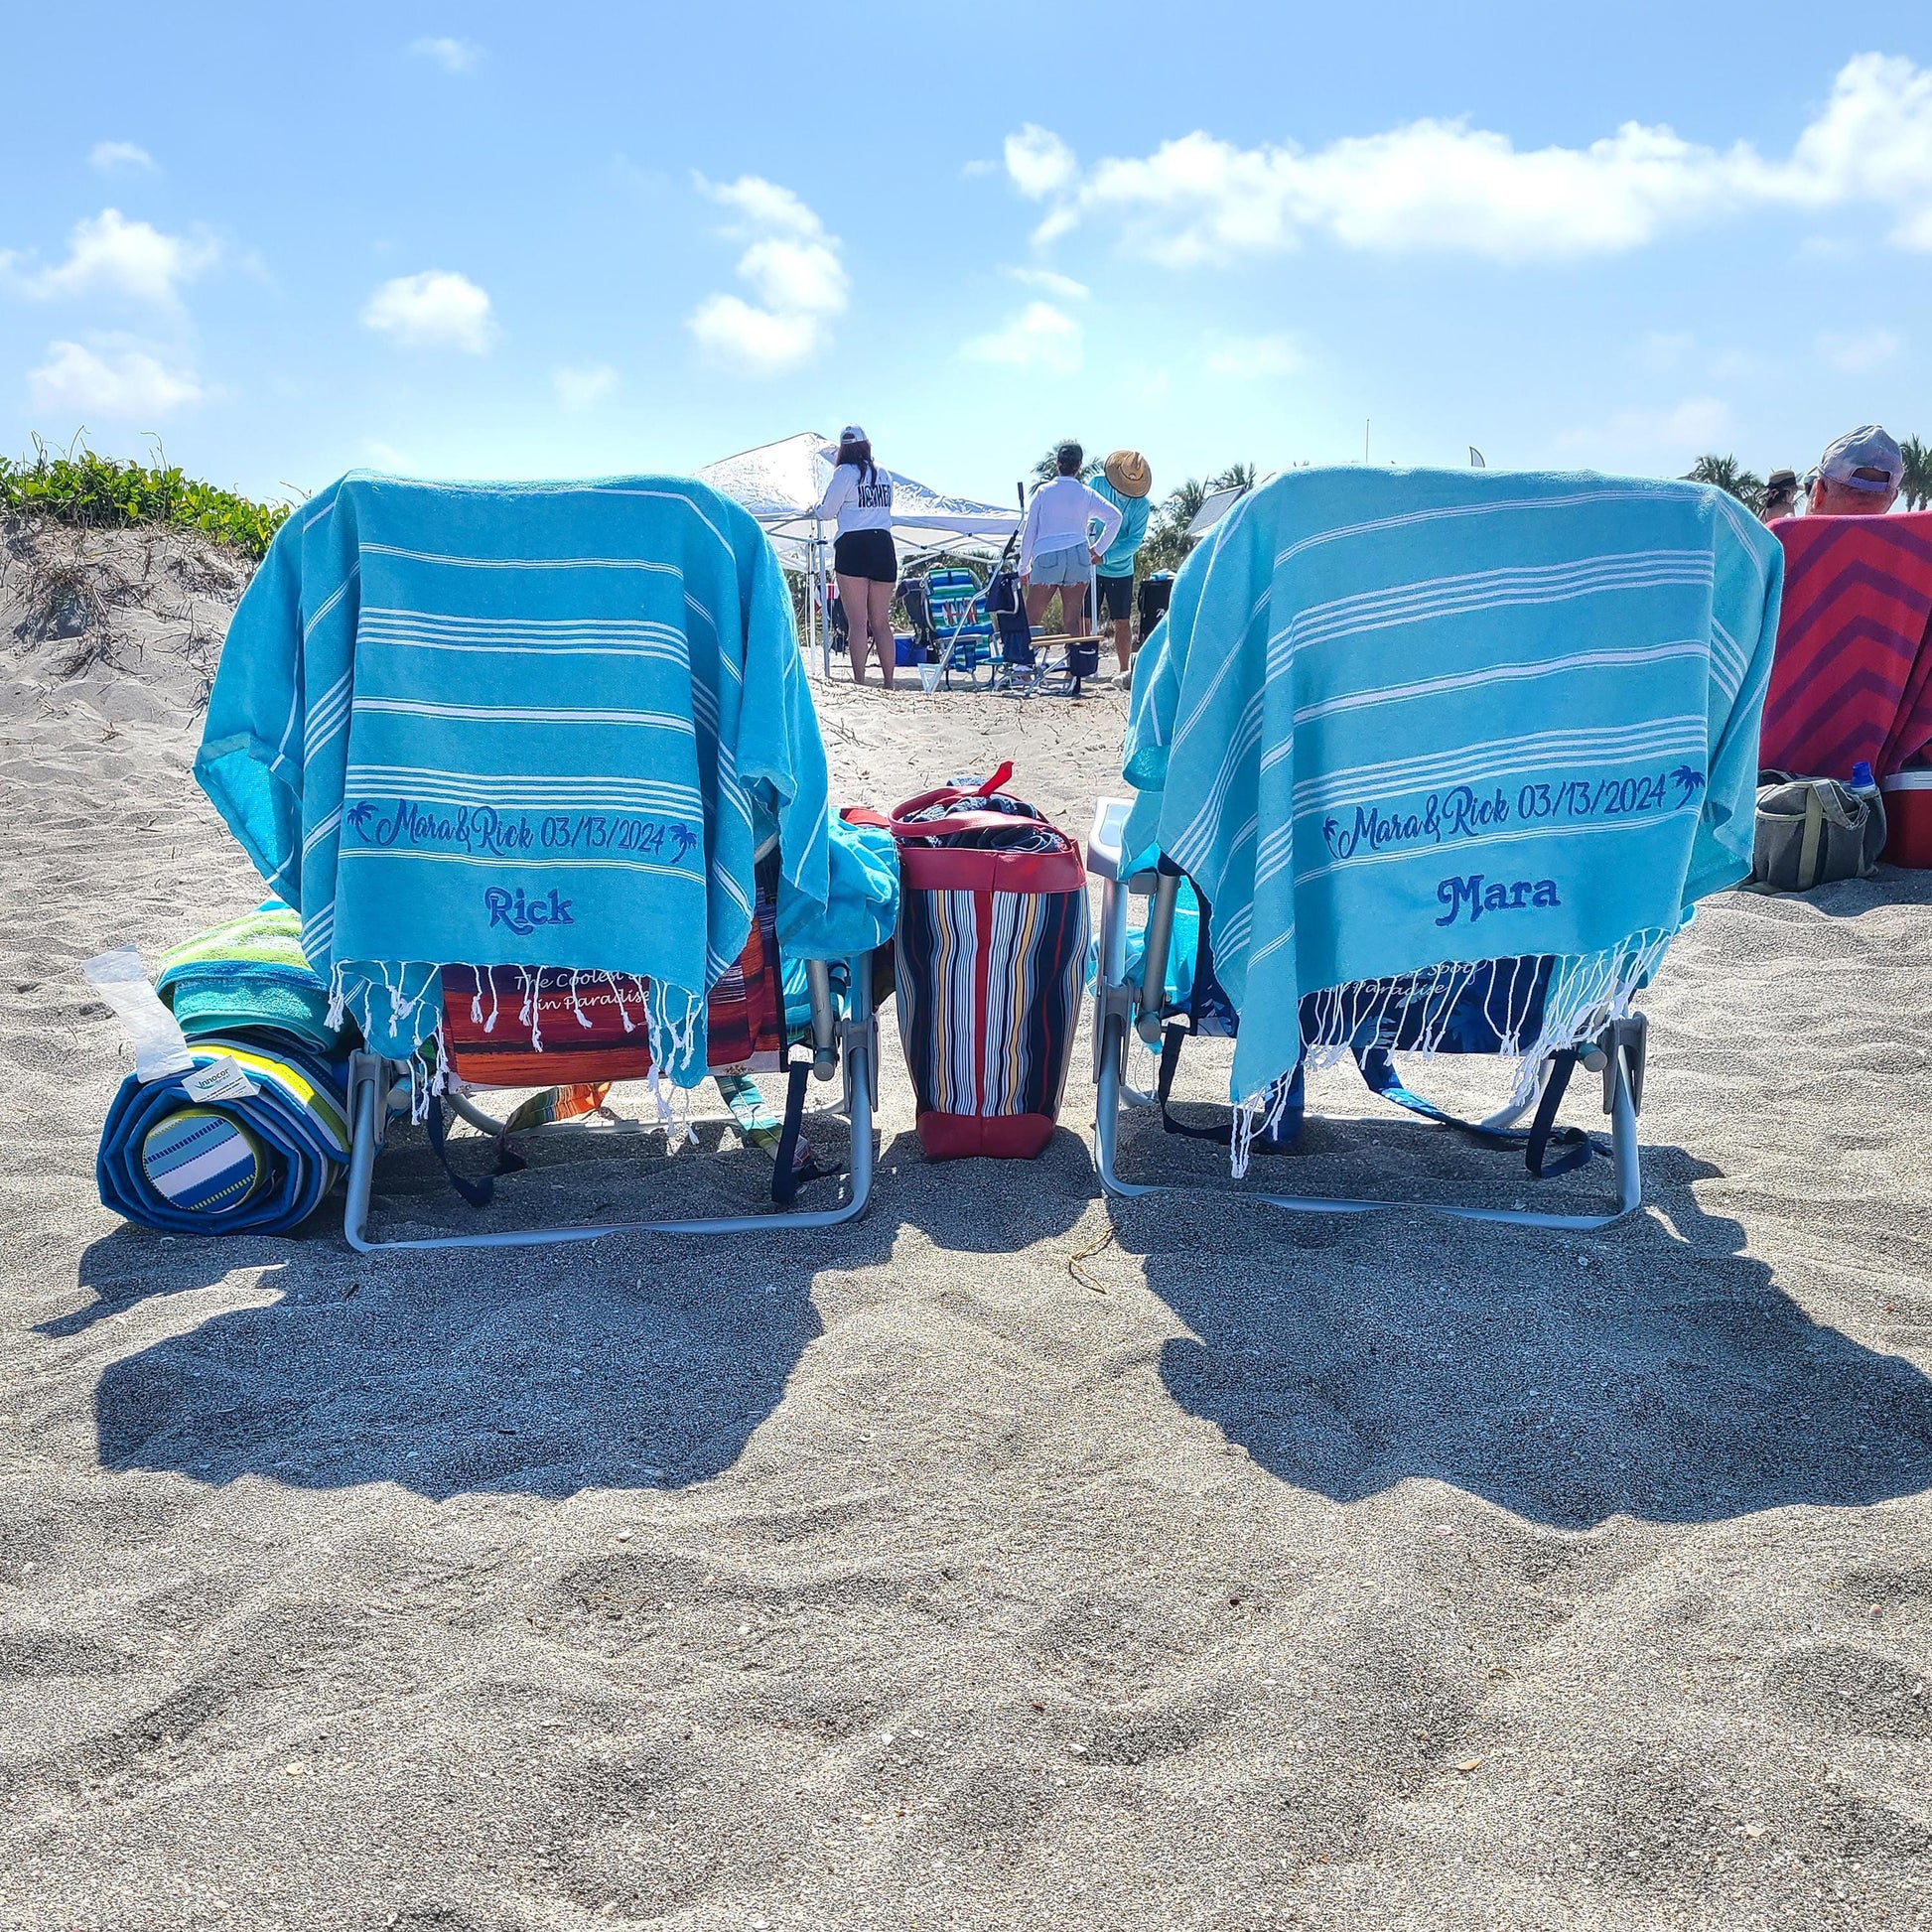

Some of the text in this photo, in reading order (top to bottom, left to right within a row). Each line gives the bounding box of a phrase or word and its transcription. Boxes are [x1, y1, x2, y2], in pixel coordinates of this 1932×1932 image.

[1517, 773, 1667, 820] 03/13/2024
[540, 815, 665, 853] 03/13/2024
[483, 887, 574, 935] Rick
[1435, 874, 1561, 927] Mara
[514, 973, 554, 991] The
[537, 989, 650, 1011] in Paradise
[1352, 979, 1449, 996] Paradise
